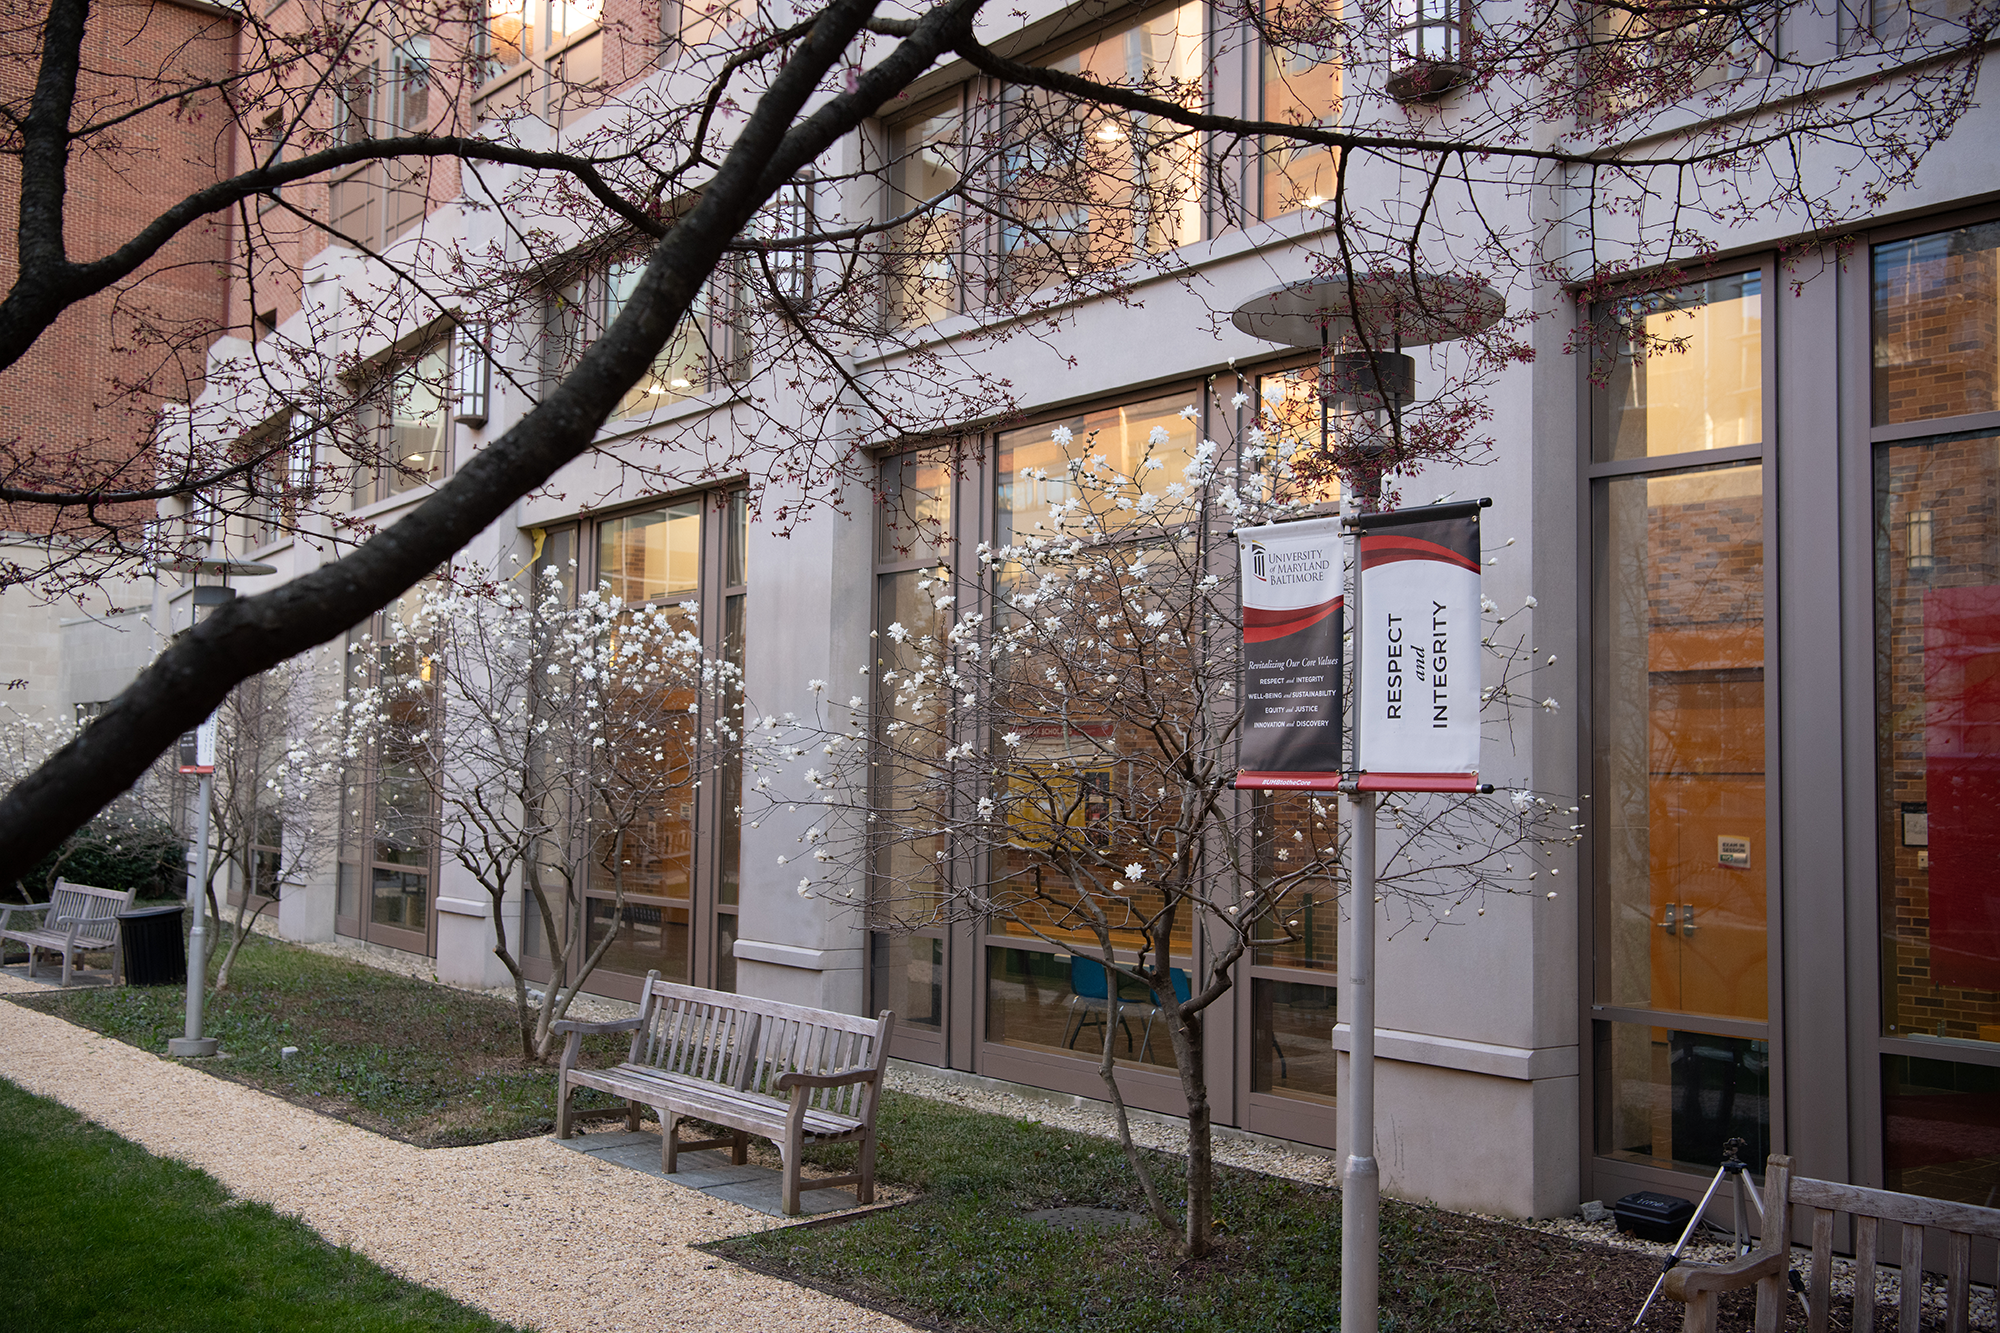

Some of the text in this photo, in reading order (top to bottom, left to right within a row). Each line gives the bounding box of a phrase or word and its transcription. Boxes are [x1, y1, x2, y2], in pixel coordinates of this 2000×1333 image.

[1268, 549, 1323, 564] UNIVERSITY
[1269, 560, 1330, 574] of MARYLAND
[1270, 571, 1324, 586] BALTIMORE
[1248, 655, 1339, 671] Revitalizing Our Core Values
[1387, 613, 1403, 719] RESPECT
[1410, 644, 1425, 682] and
[1432, 600, 1448, 729] INTEGRITY
[1259, 677, 1285, 685] RESPECT
[1295, 675, 1324, 683] INTEGRITY
[1247, 692, 1282, 700] WELL-BEING
[1292, 689, 1337, 698] SUSTAINABILITY
[1264, 706, 1285, 714] EQUITY
[1294, 705, 1318, 713] JUSTICE
[1041, 727, 1073, 736] SCHOLAS
[1253, 721, 1286, 729] INNOVATION
